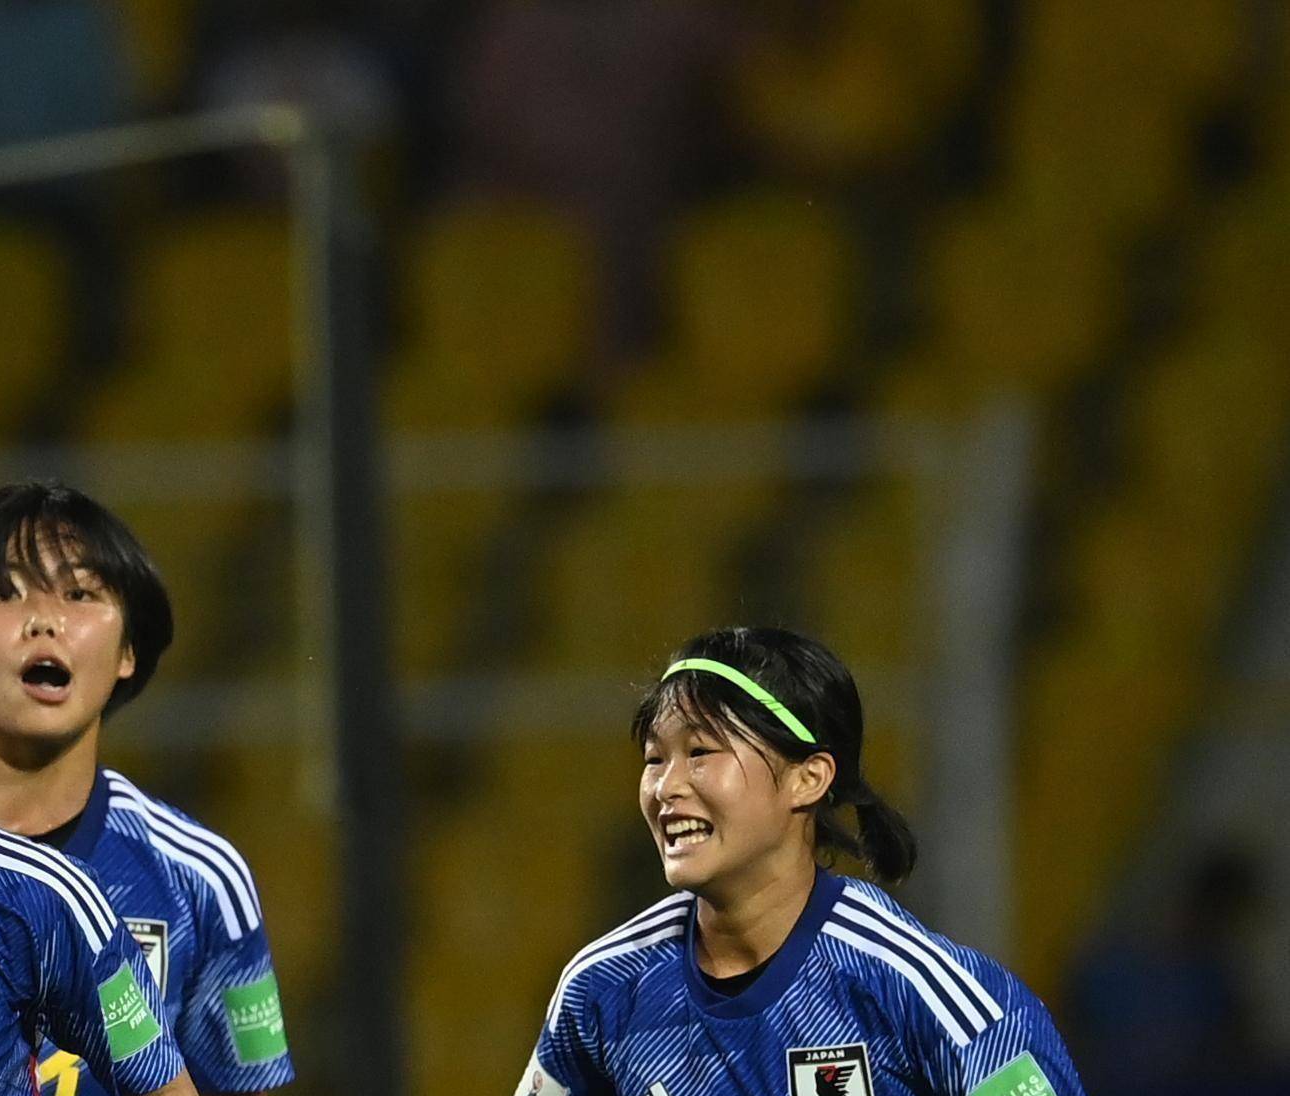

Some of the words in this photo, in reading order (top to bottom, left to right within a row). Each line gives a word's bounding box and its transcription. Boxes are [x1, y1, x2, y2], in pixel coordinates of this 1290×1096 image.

[127, 923, 151, 933] PAN
[108, 982, 135, 1011] VING
[108, 992, 139, 1021] OTBALL
[805, 1049, 846, 1062] JAPAN
